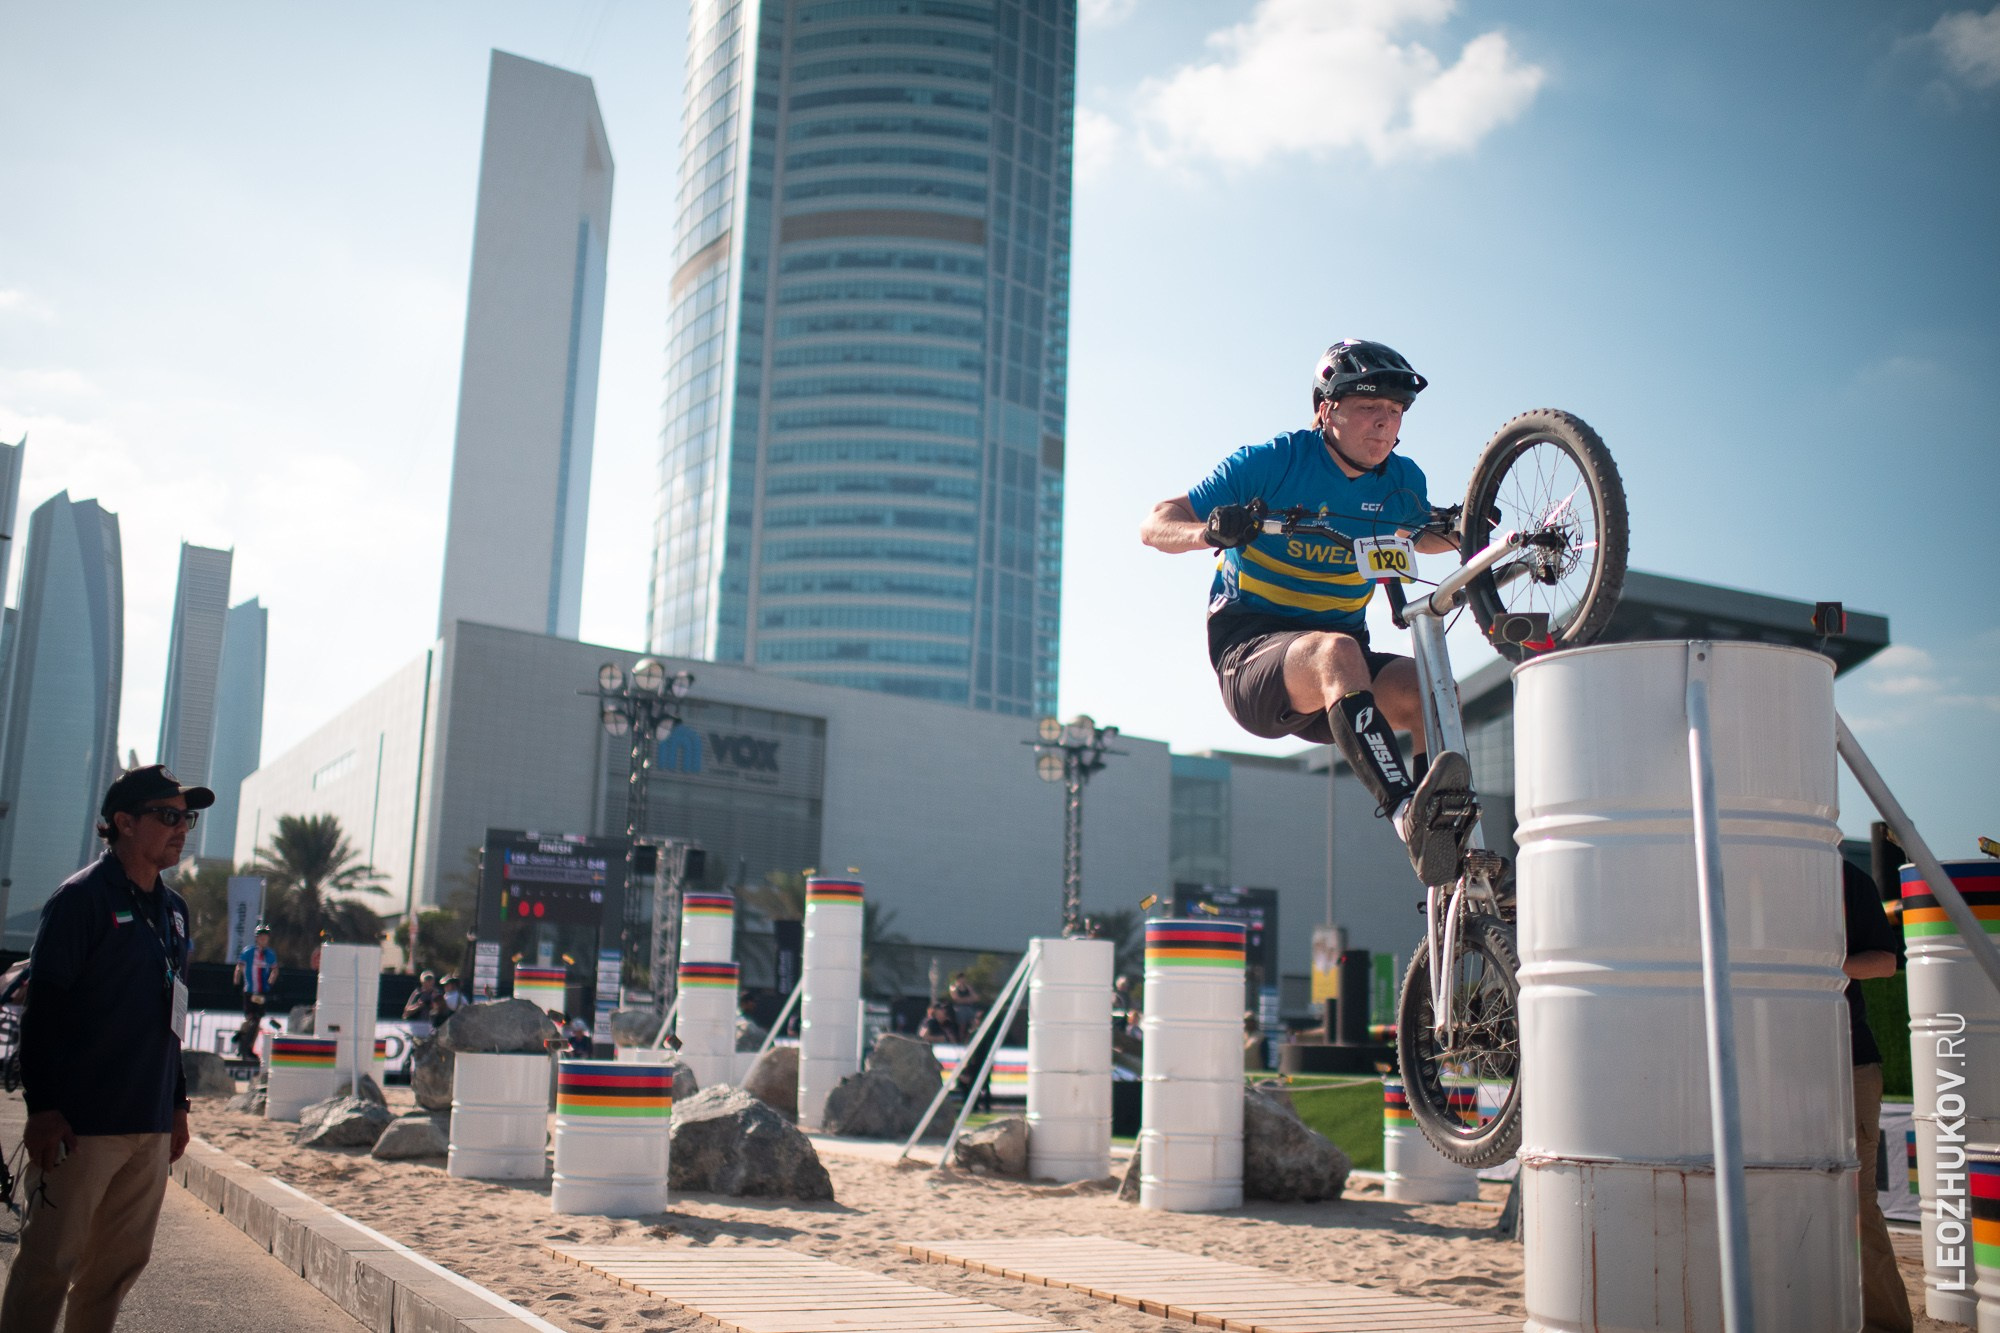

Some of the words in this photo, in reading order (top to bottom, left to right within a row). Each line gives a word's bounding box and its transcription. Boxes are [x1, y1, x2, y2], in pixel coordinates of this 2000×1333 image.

[1356, 383, 1377, 392] POC
[1373, 551, 1407, 570] 120
[709, 733, 780, 772] VOX
[539, 843, 572, 854] FINISH
